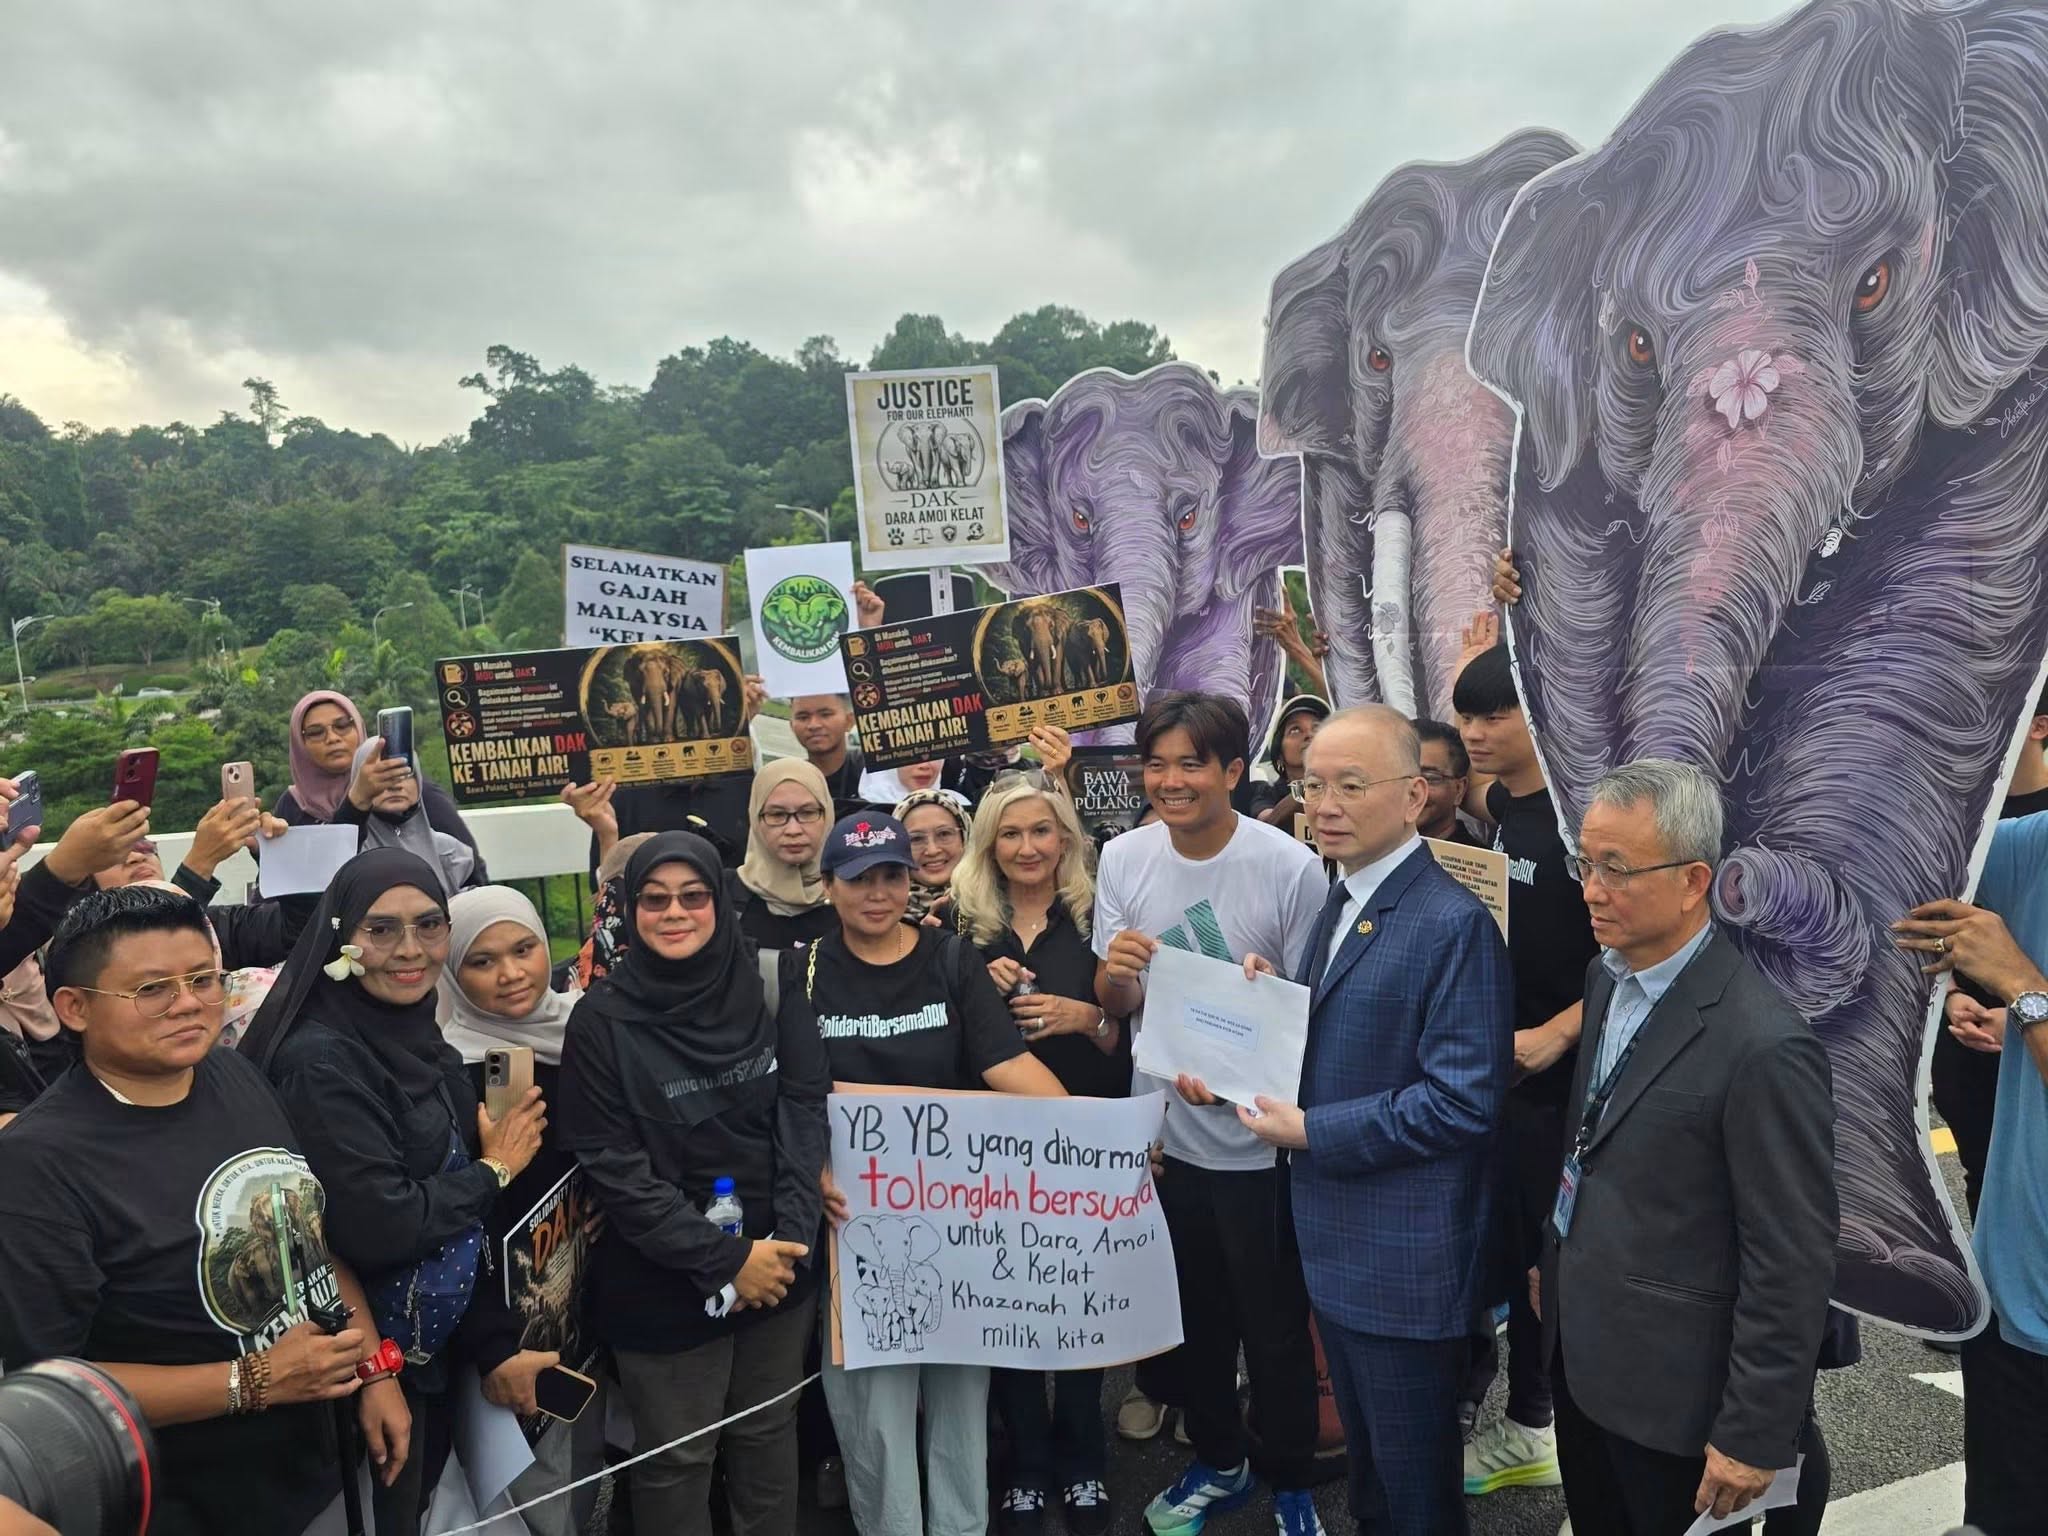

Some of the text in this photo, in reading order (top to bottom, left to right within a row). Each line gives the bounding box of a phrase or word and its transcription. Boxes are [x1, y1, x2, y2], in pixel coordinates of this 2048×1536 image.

[877, 378, 974, 410] JUSTICE
[887, 407, 973, 421] FOR OUR ELEPHANT!
[911, 490, 959, 509] DAK
[885, 507, 984, 525] DARA AMOI KELAT
[570, 555, 717, 586] SELAMATKAN
[600, 581, 688, 605] GAJAH
[576, 601, 708, 632] MALAYSIA
[772, 636, 828, 658] KEMBALIKAN
[858, 693, 983, 734] KEMBALIKAN DAK
[450, 732, 587, 763] KEMBALIKAN DAK
[862, 732, 883, 753] KE
[885, 721, 935, 748] TANAH
[939, 715, 968, 738] AIR!
[452, 754, 569, 783] KE TANAH AIR!
[1083, 770, 1130, 785] BAWA
[1074, 795, 1141, 810] PULANG
[1086, 783, 1128, 797] KAMI
[840, 1102, 1151, 1174] YB, YB, yang dihormat
[859, 1155, 1020, 1219] tolonglah
[529, 1182, 569, 1233] SOLIDARITY
[948, 1221, 1156, 1256] untuk Dara, Amoi
[992, 1247, 1095, 1286] & Kelat
[952, 1279, 1066, 1316] Khazanah
[982, 1323, 1105, 1350] milik kita
